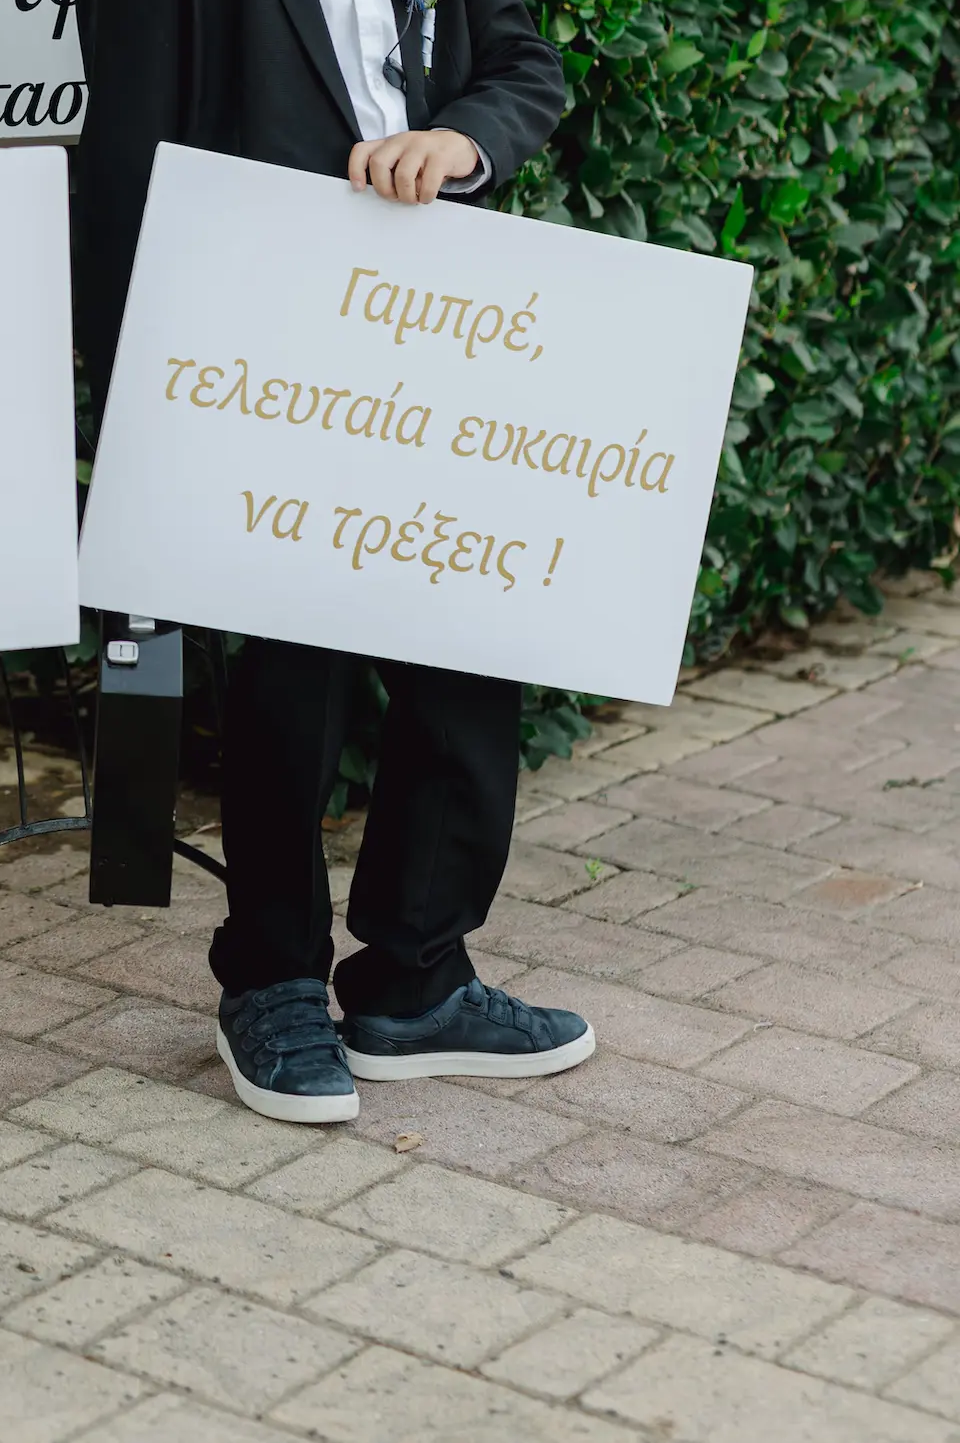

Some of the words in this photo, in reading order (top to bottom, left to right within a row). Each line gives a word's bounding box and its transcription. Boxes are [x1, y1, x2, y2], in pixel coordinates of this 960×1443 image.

[339, 267, 545, 362] Γαμπρέ,
[165, 357, 432, 450] τελευταία
[450, 415, 676, 499] ευκαιρία
[240, 490, 309, 543] να
[332, 501, 528, 592] τρέξεις
